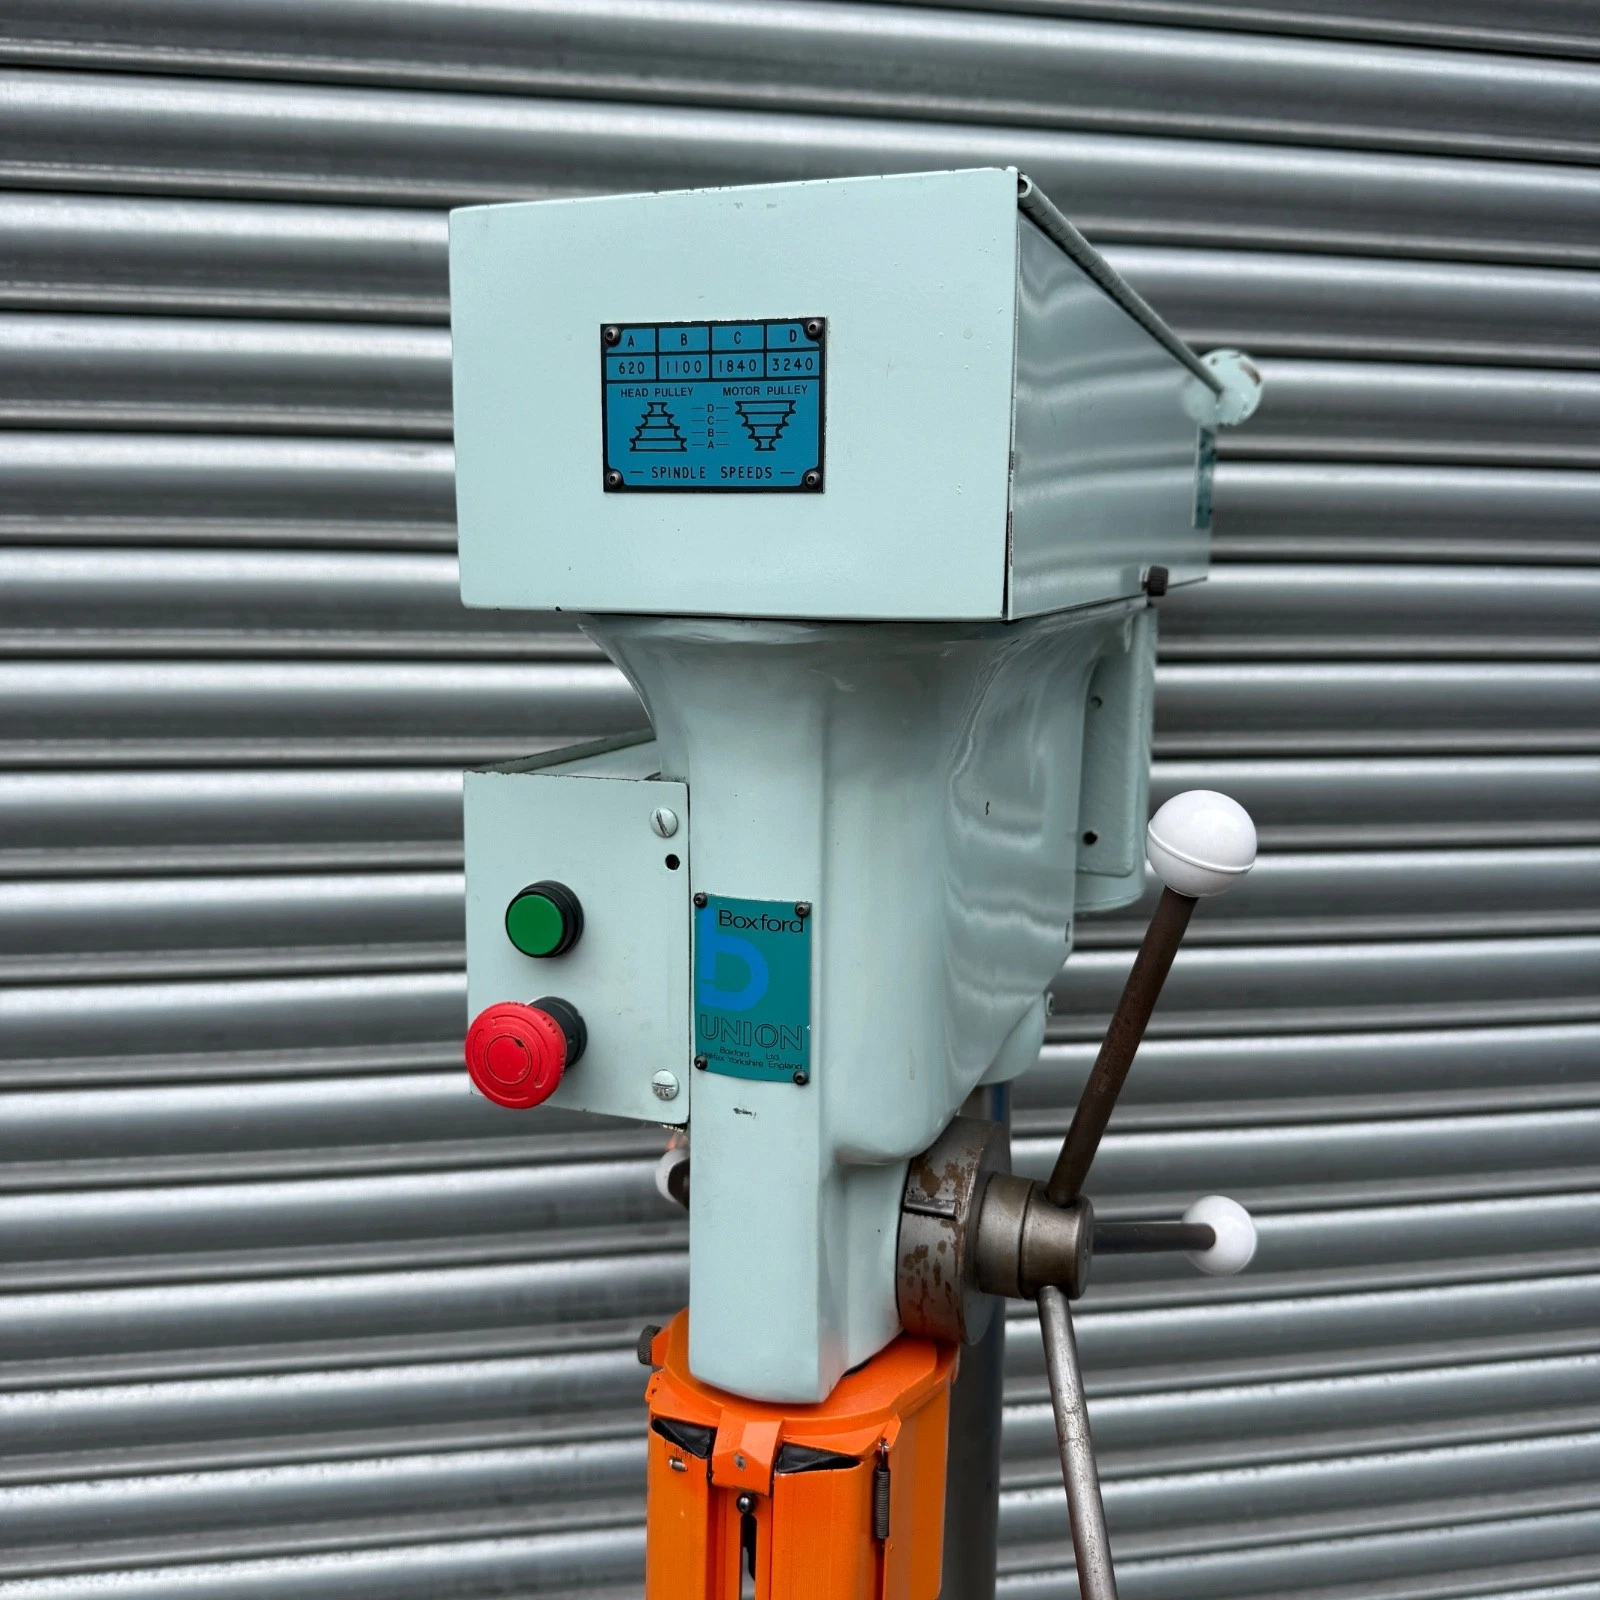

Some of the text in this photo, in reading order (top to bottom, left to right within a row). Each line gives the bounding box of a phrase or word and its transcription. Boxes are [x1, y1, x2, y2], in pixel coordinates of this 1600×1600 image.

[627, 335, 635, 348] A
[680, 332, 688, 347] B
[733, 331, 742, 344] C
[789, 329, 798, 343] D
[618, 360, 645, 375] 620
[665, 360, 702, 374] 1100
[719, 359, 757, 373] 1840
[772, 357, 814, 371] 3240
[620, 387, 694, 398] HEAD PULLEY
[722, 385, 808, 397] MOTOR PULLEY
[707, 404, 715, 413] D
[707, 416, 715, 425] C
[707, 429, 715, 438] B
[707, 440, 715, 450] A
[651, 466, 773, 480] SPINDLE SPEEDS
[719, 909, 804, 933] Boxford
[700, 1014, 803, 1051] UNION
[720, 1046, 750, 1058] Boxford
[728, 1056, 764, 1067] Yorkshire
[768, 1061, 803, 1070] England
